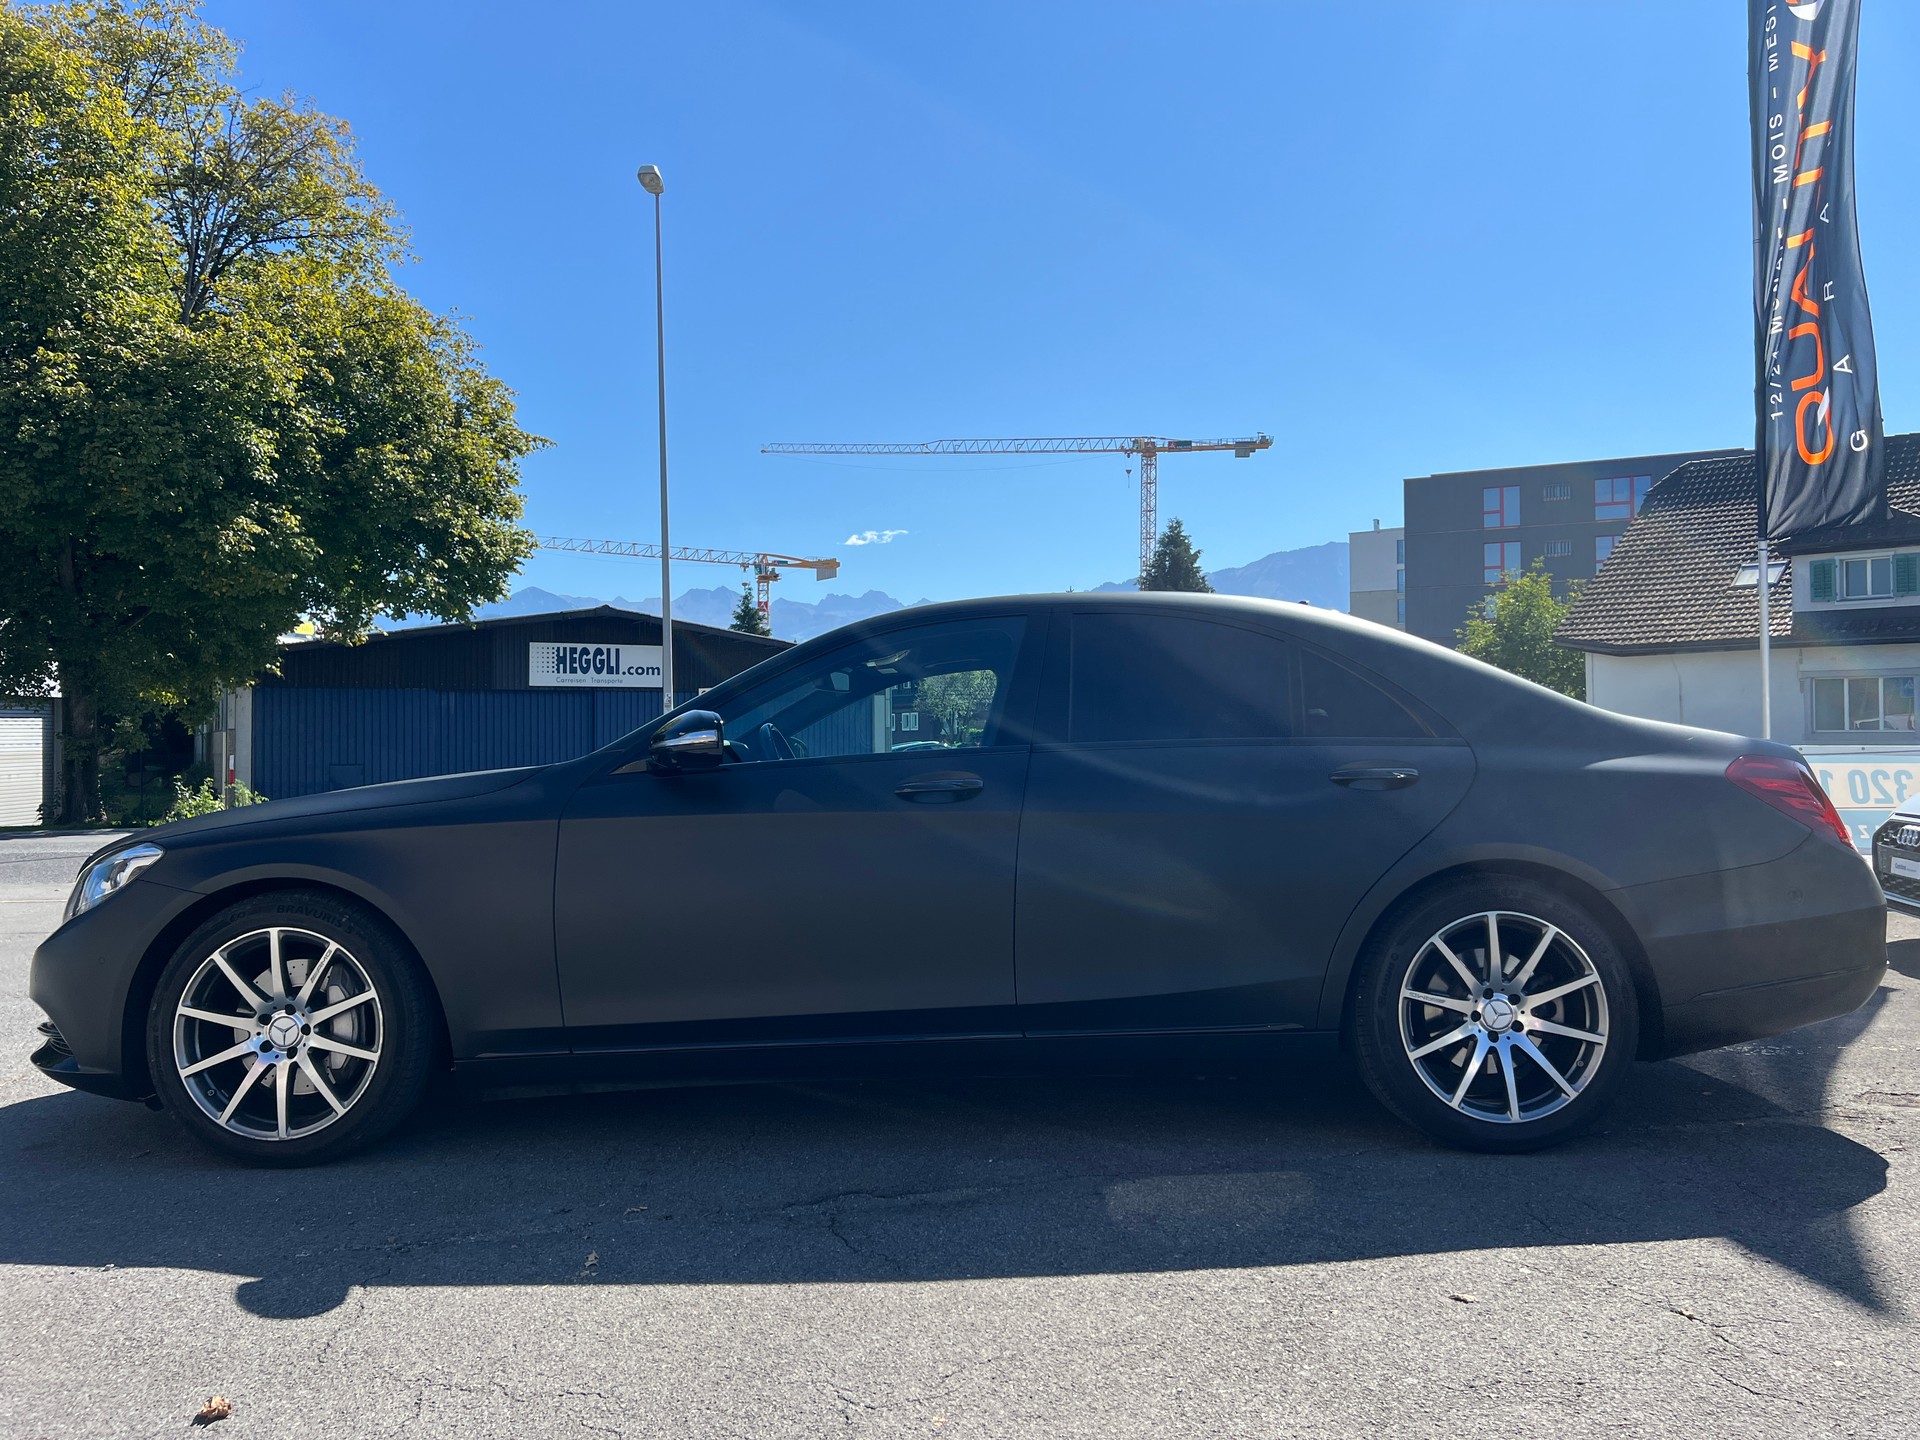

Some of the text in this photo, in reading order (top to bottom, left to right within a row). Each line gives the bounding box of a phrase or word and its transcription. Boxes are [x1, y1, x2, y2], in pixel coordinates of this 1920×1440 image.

[1765, 5, 1779, 72] MESI
[1769, 113, 1789, 184] MOIS
[555, 646, 661, 676] HEGGLI.com
[591, 677, 624, 685] Transporte
[276, 904, 343, 929] BRAVURIS
